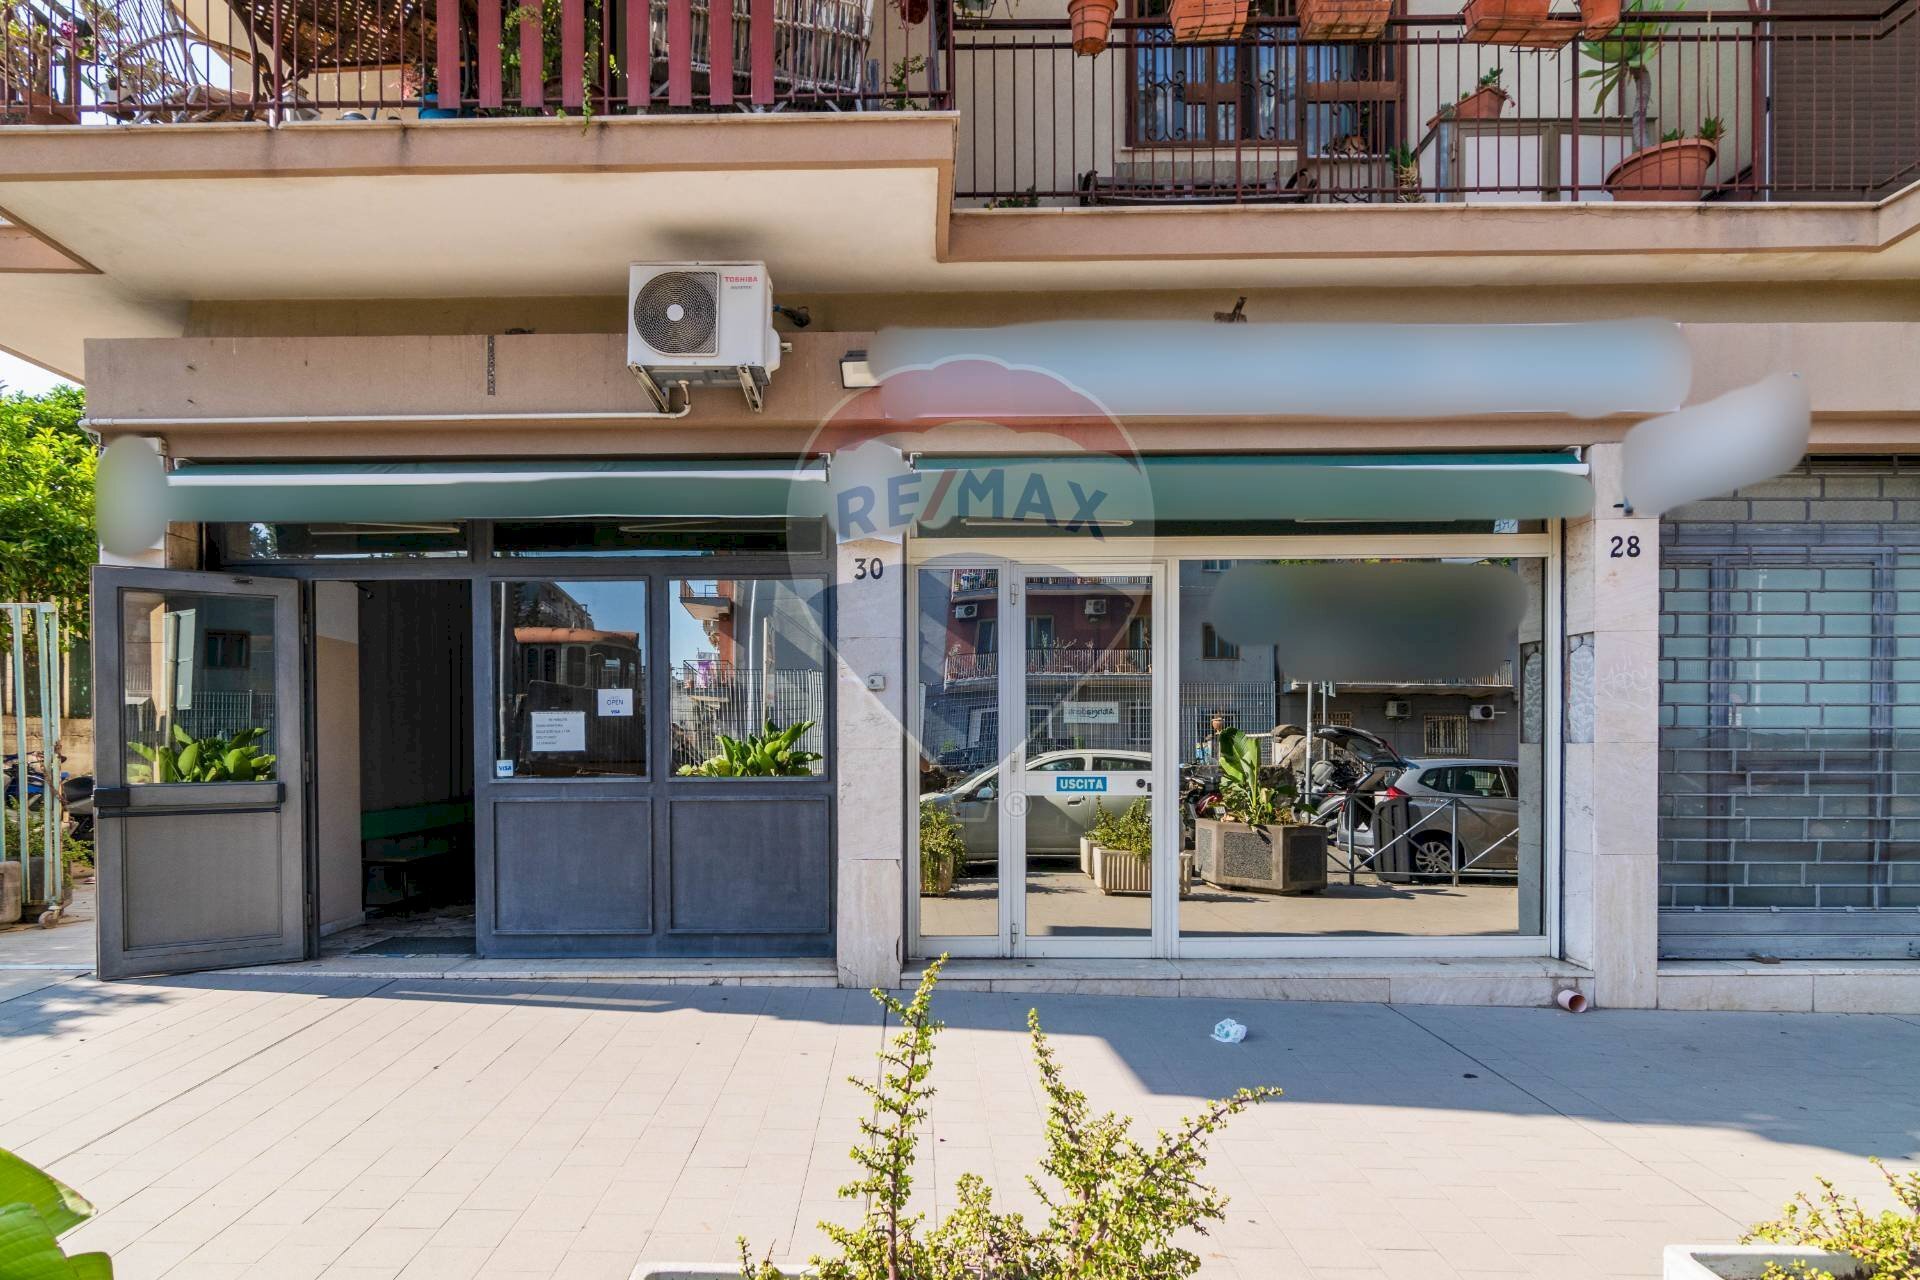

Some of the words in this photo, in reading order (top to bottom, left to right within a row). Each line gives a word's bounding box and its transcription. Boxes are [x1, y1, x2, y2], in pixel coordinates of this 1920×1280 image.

[1610, 535, 1641, 558] 28
[854, 557, 884, 580] 30
[1059, 778, 1104, 790] USCITA
